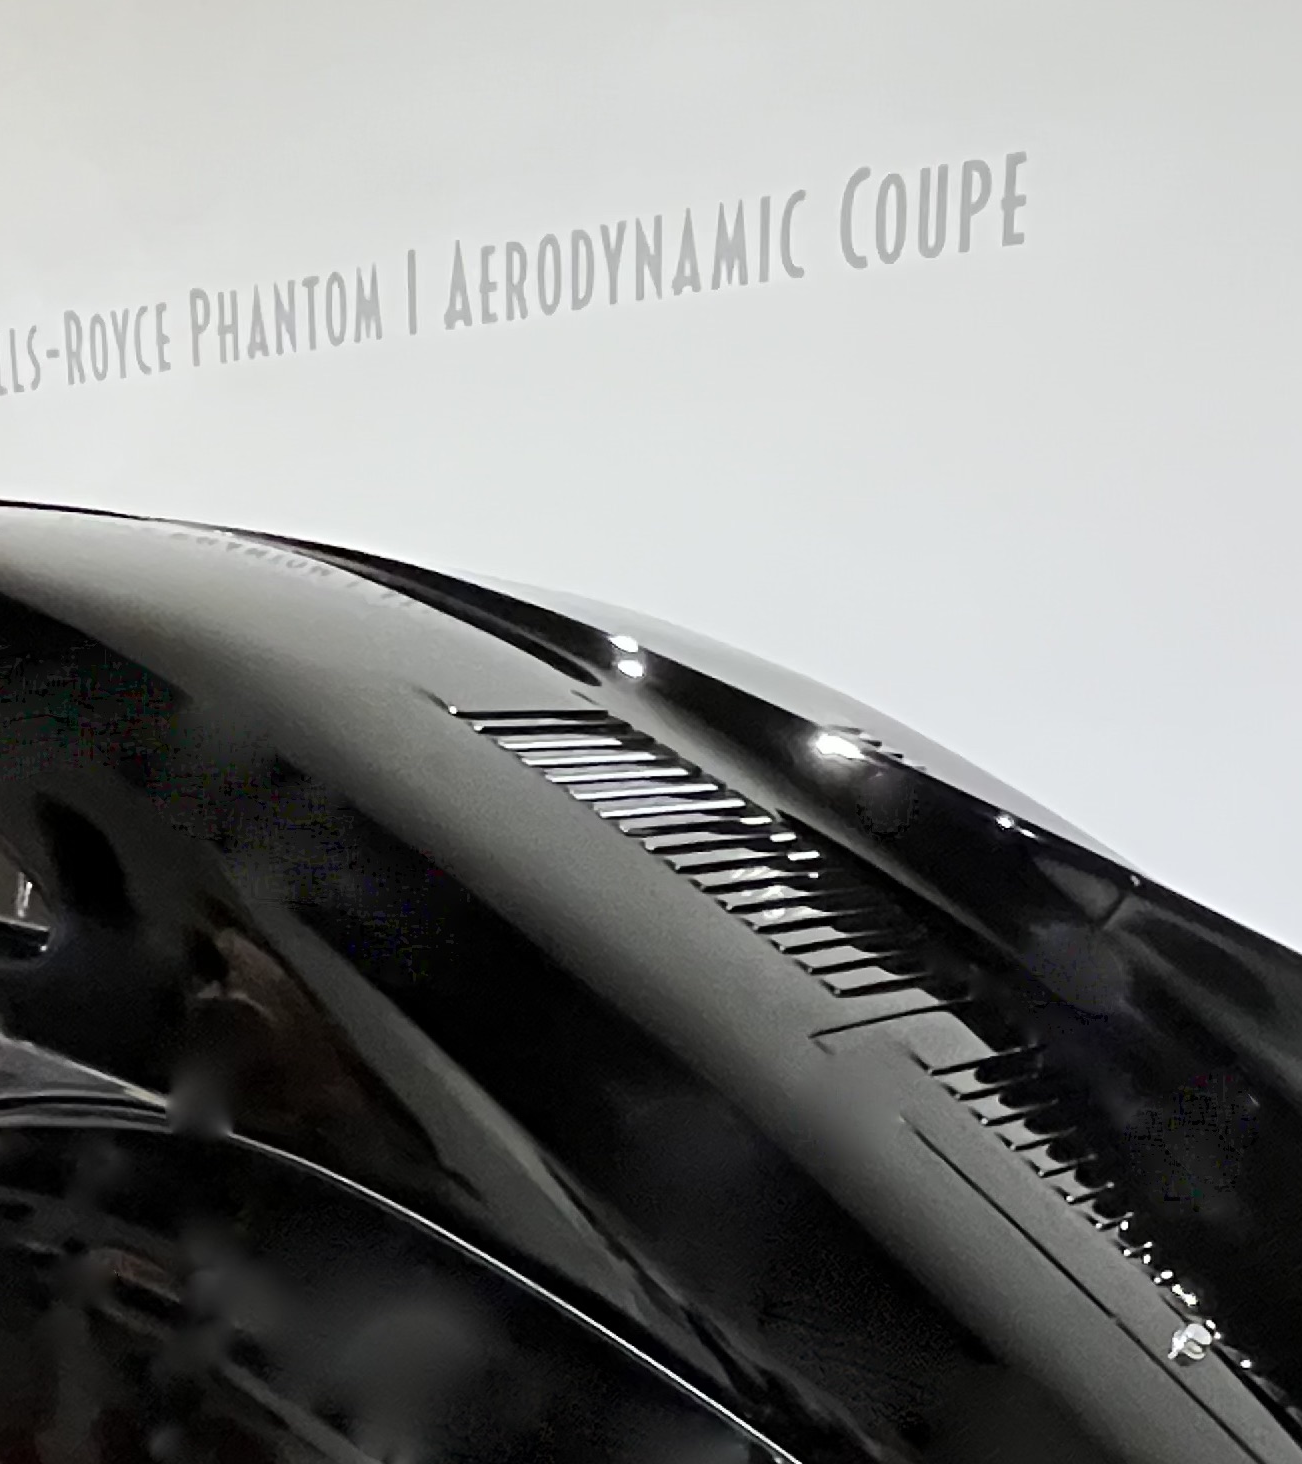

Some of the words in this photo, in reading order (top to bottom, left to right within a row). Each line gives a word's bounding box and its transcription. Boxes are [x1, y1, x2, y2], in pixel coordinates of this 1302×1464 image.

[189, 263, 384, 368] PHANTOM
[443, 189, 807, 331] AERODYNAMIC
[839, 150, 1028, 270] COUPE
